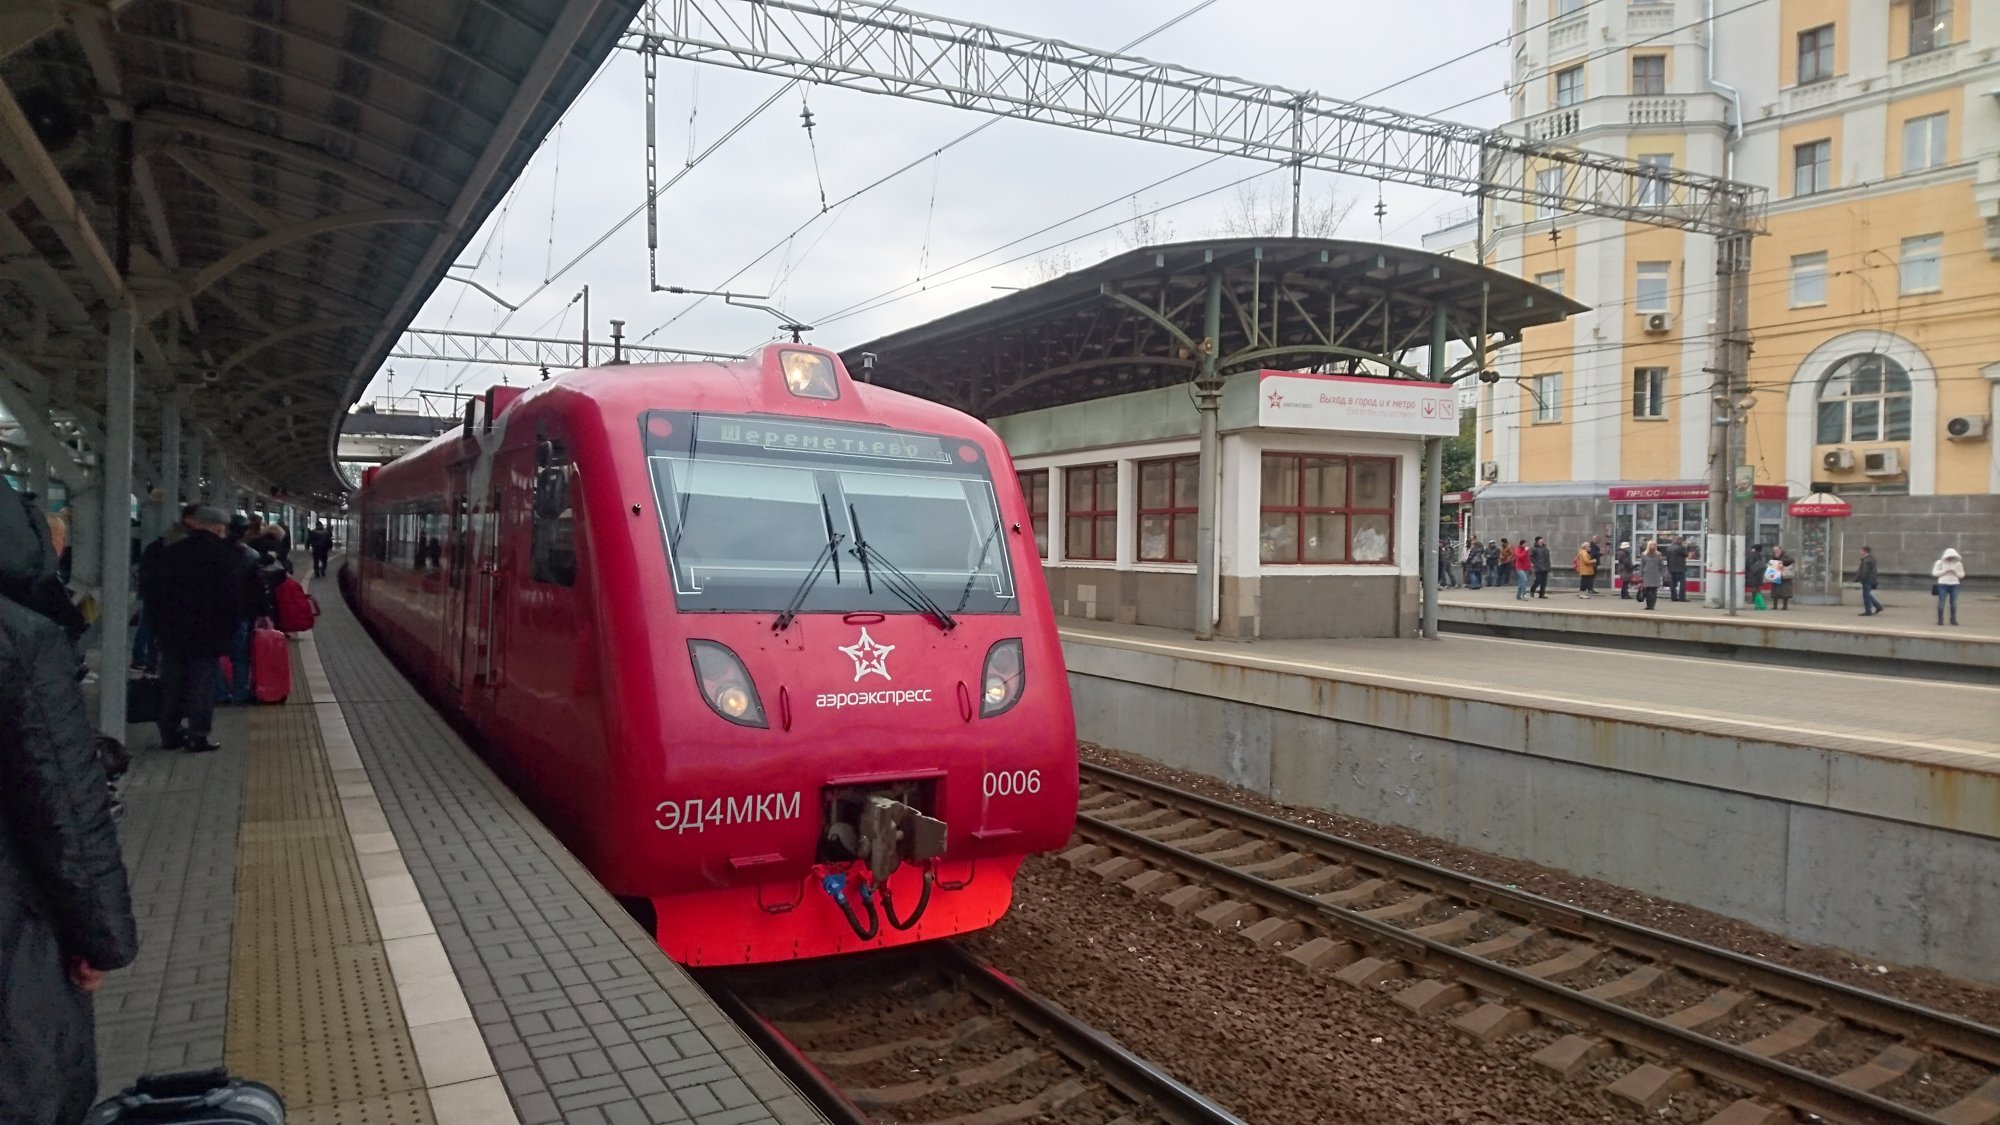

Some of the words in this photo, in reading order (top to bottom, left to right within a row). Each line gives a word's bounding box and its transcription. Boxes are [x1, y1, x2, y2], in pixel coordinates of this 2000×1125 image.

[1319, 393, 1346, 405] Выход
[1348, 397, 1354, 405] в
[1355, 397, 1378, 408] город
[1379, 399, 1385, 407] и
[1386, 399, 1392, 407] к
[1392, 400, 1416, 409] метро
[721, 424, 918, 456] Шереметьево
[1626, 489, 1661, 497] ПРЕСС
[816, 688, 932, 709] аэроэкспресс
[982, 769, 1042, 797] 0006
[654, 791, 801, 834] ЭД4МКМ
